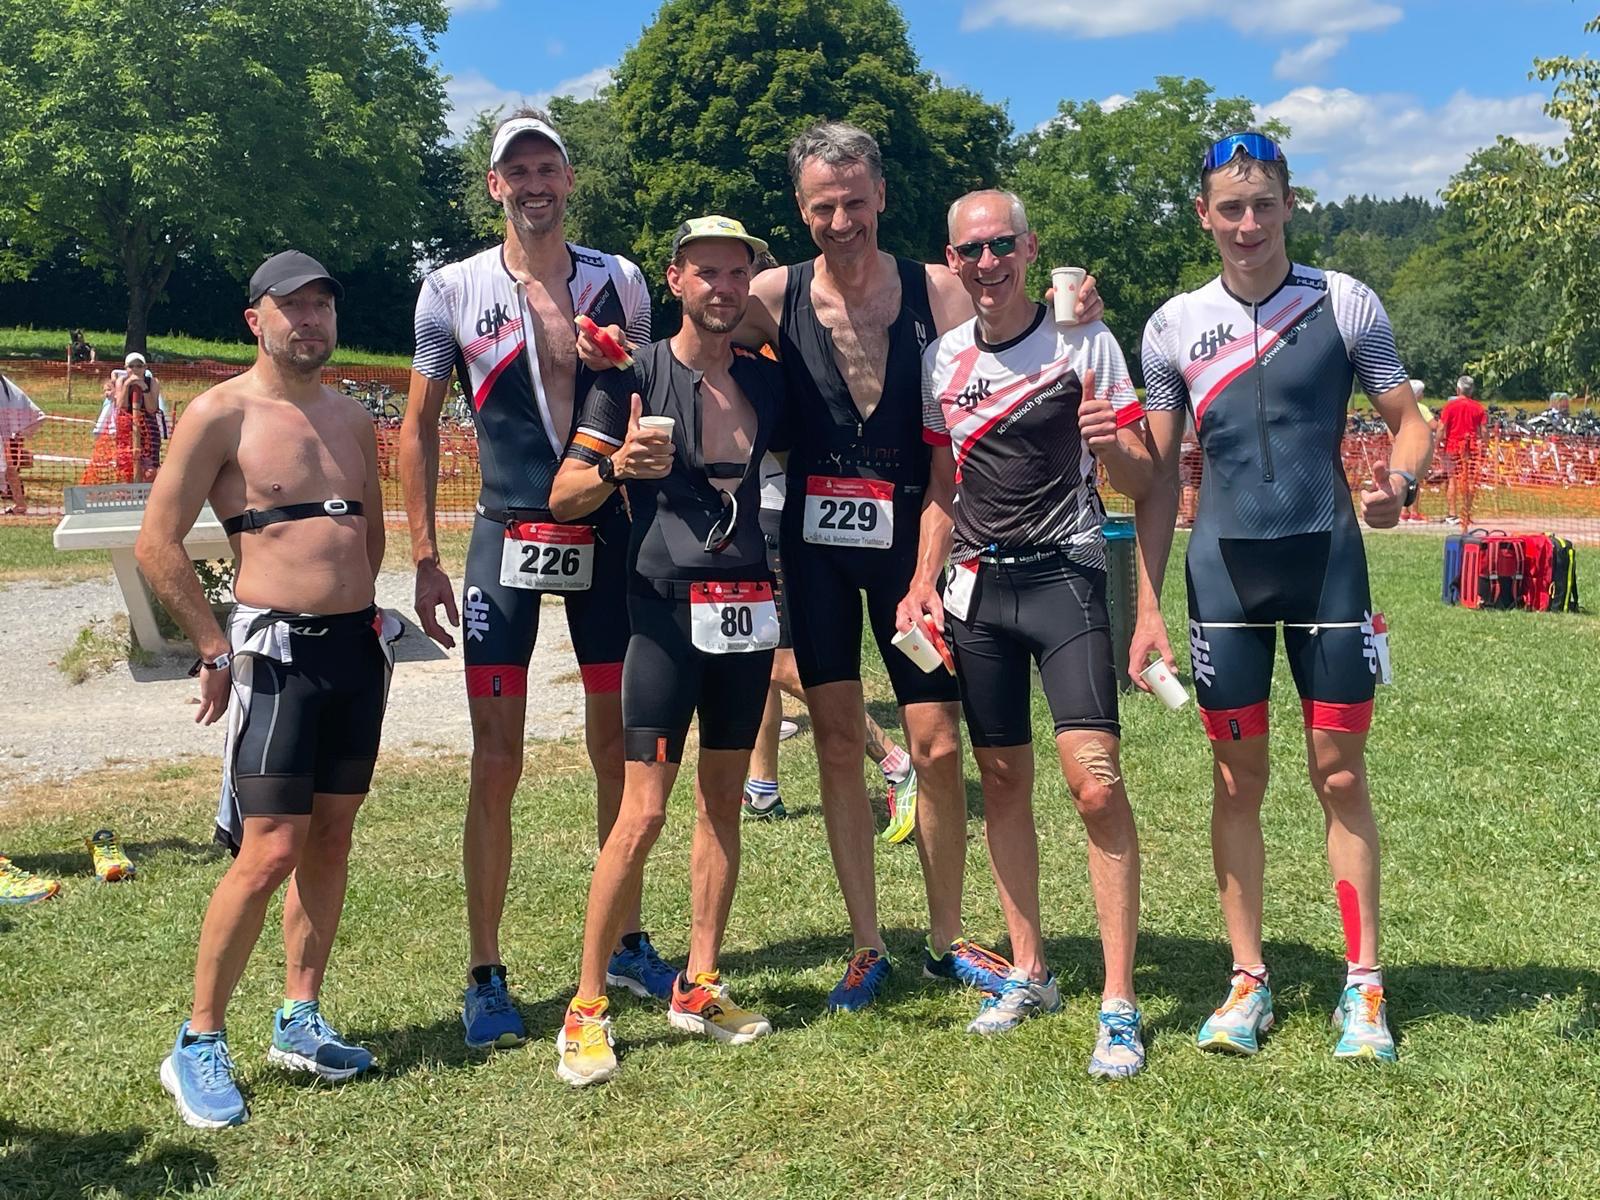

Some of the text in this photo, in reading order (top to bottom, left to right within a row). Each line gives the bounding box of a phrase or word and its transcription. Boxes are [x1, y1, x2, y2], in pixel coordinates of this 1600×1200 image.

[476, 302, 512, 340] djk
[1261, 305, 1323, 367] schwäbisch gmünd
[1189, 322, 1239, 363] djk
[997, 399, 1036, 435] schwäbisch
[1034, 380, 1063, 406] gmünd
[818, 500, 878, 532] 229
[519, 544, 580, 576] 226
[464, 586, 490, 643] djk
[721, 606, 753, 637] 80
[1189, 618, 1216, 688] djk
